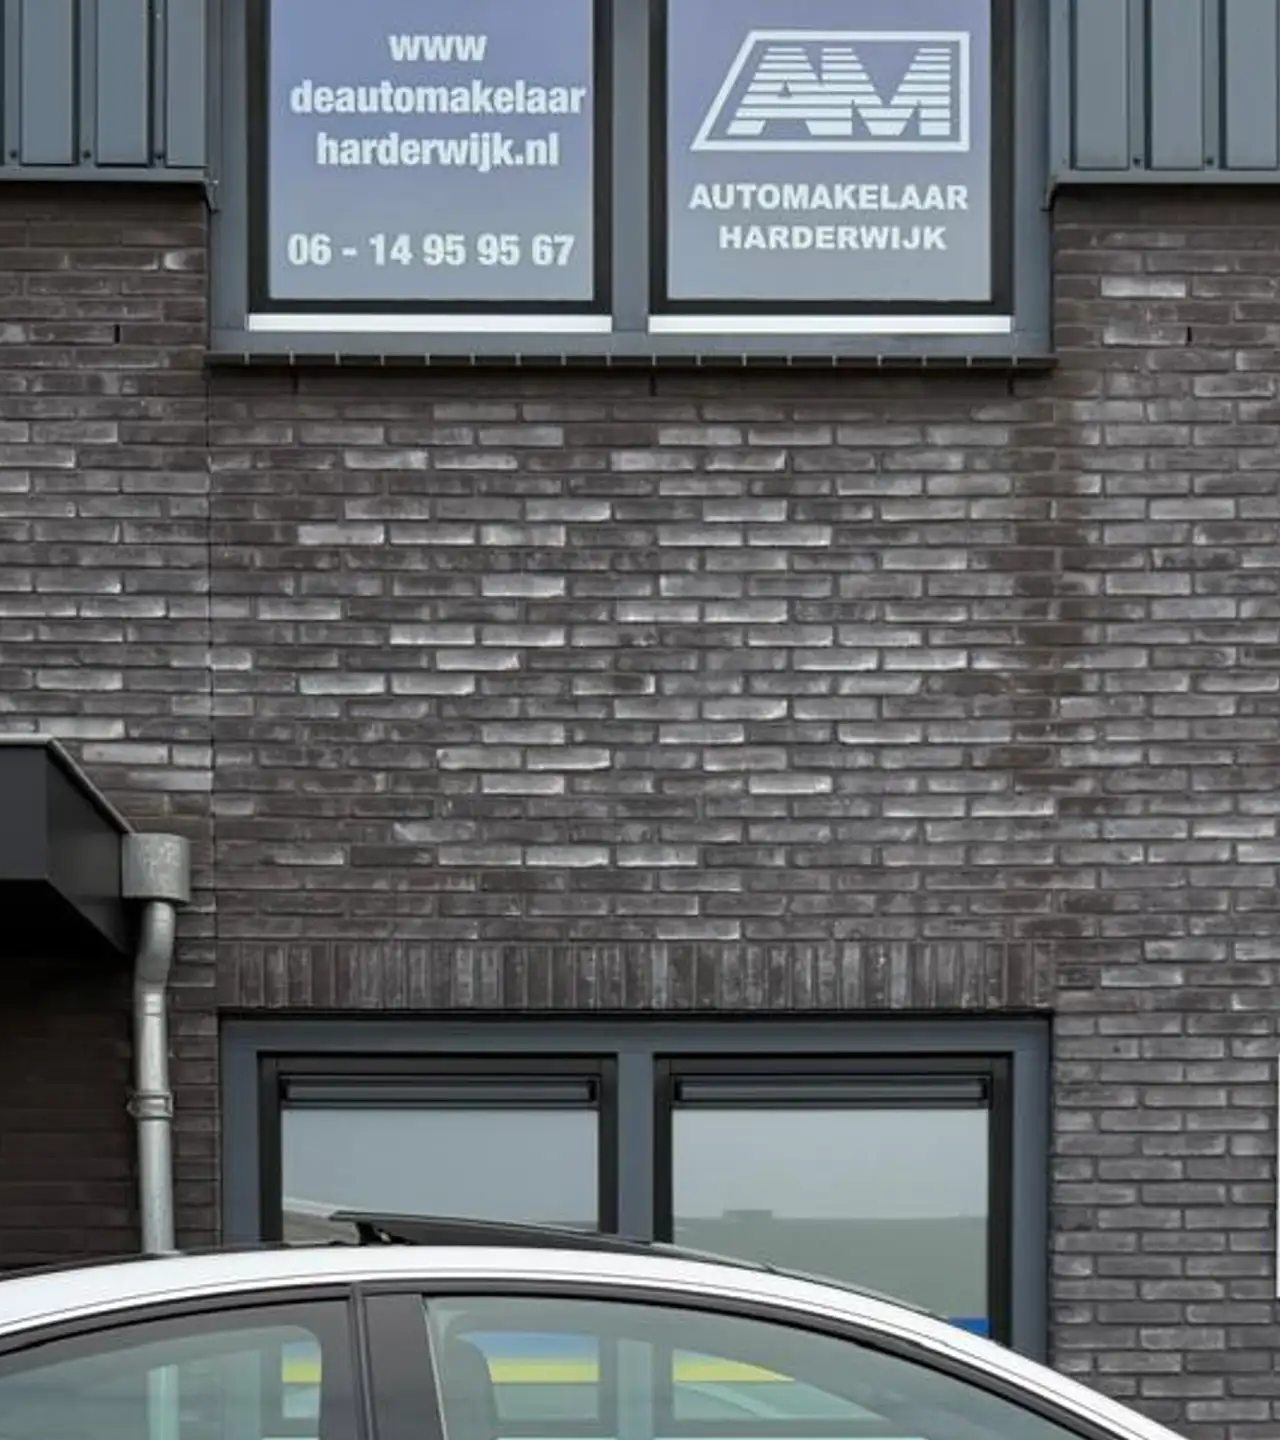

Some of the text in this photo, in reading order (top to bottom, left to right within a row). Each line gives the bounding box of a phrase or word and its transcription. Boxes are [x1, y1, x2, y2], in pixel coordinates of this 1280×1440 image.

[388, 34, 487, 62] www
[289, 80, 587, 114] deautomakelaar
[316, 132, 560, 173] harderwijk.nl
[688, 183, 969, 211] AUTOMAKELAAR
[287, 233, 333, 267] 06
[370, 233, 413, 267] 14
[423, 233, 466, 267] 95
[477, 233, 520, 267] 95
[531, 233, 575, 267] 67
[719, 225, 948, 251] HARDERWIJK
